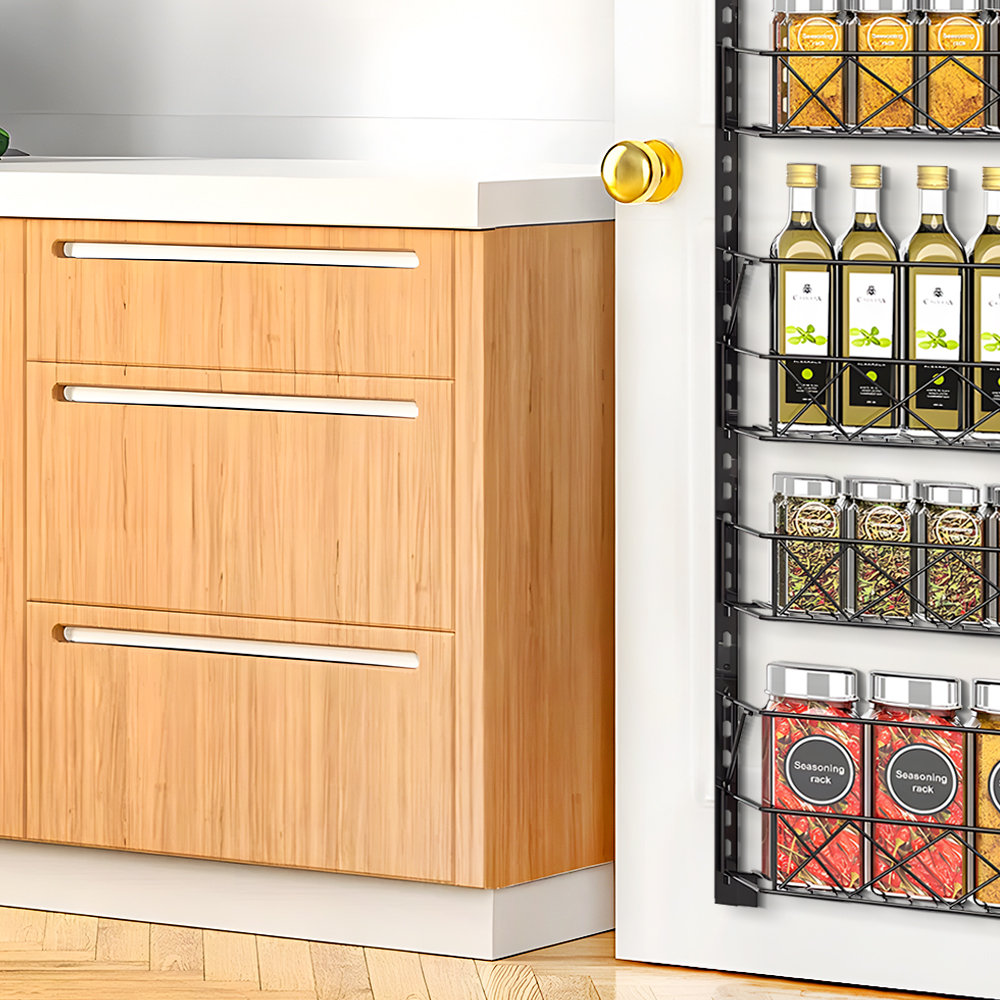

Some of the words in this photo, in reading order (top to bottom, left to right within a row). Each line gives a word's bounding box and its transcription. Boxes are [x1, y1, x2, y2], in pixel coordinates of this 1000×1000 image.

[794, 761, 846, 776] Seasoning
[810, 775, 832, 785] rack
[895, 770, 948, 785] Seasoning
[912, 783, 934, 794] rack
